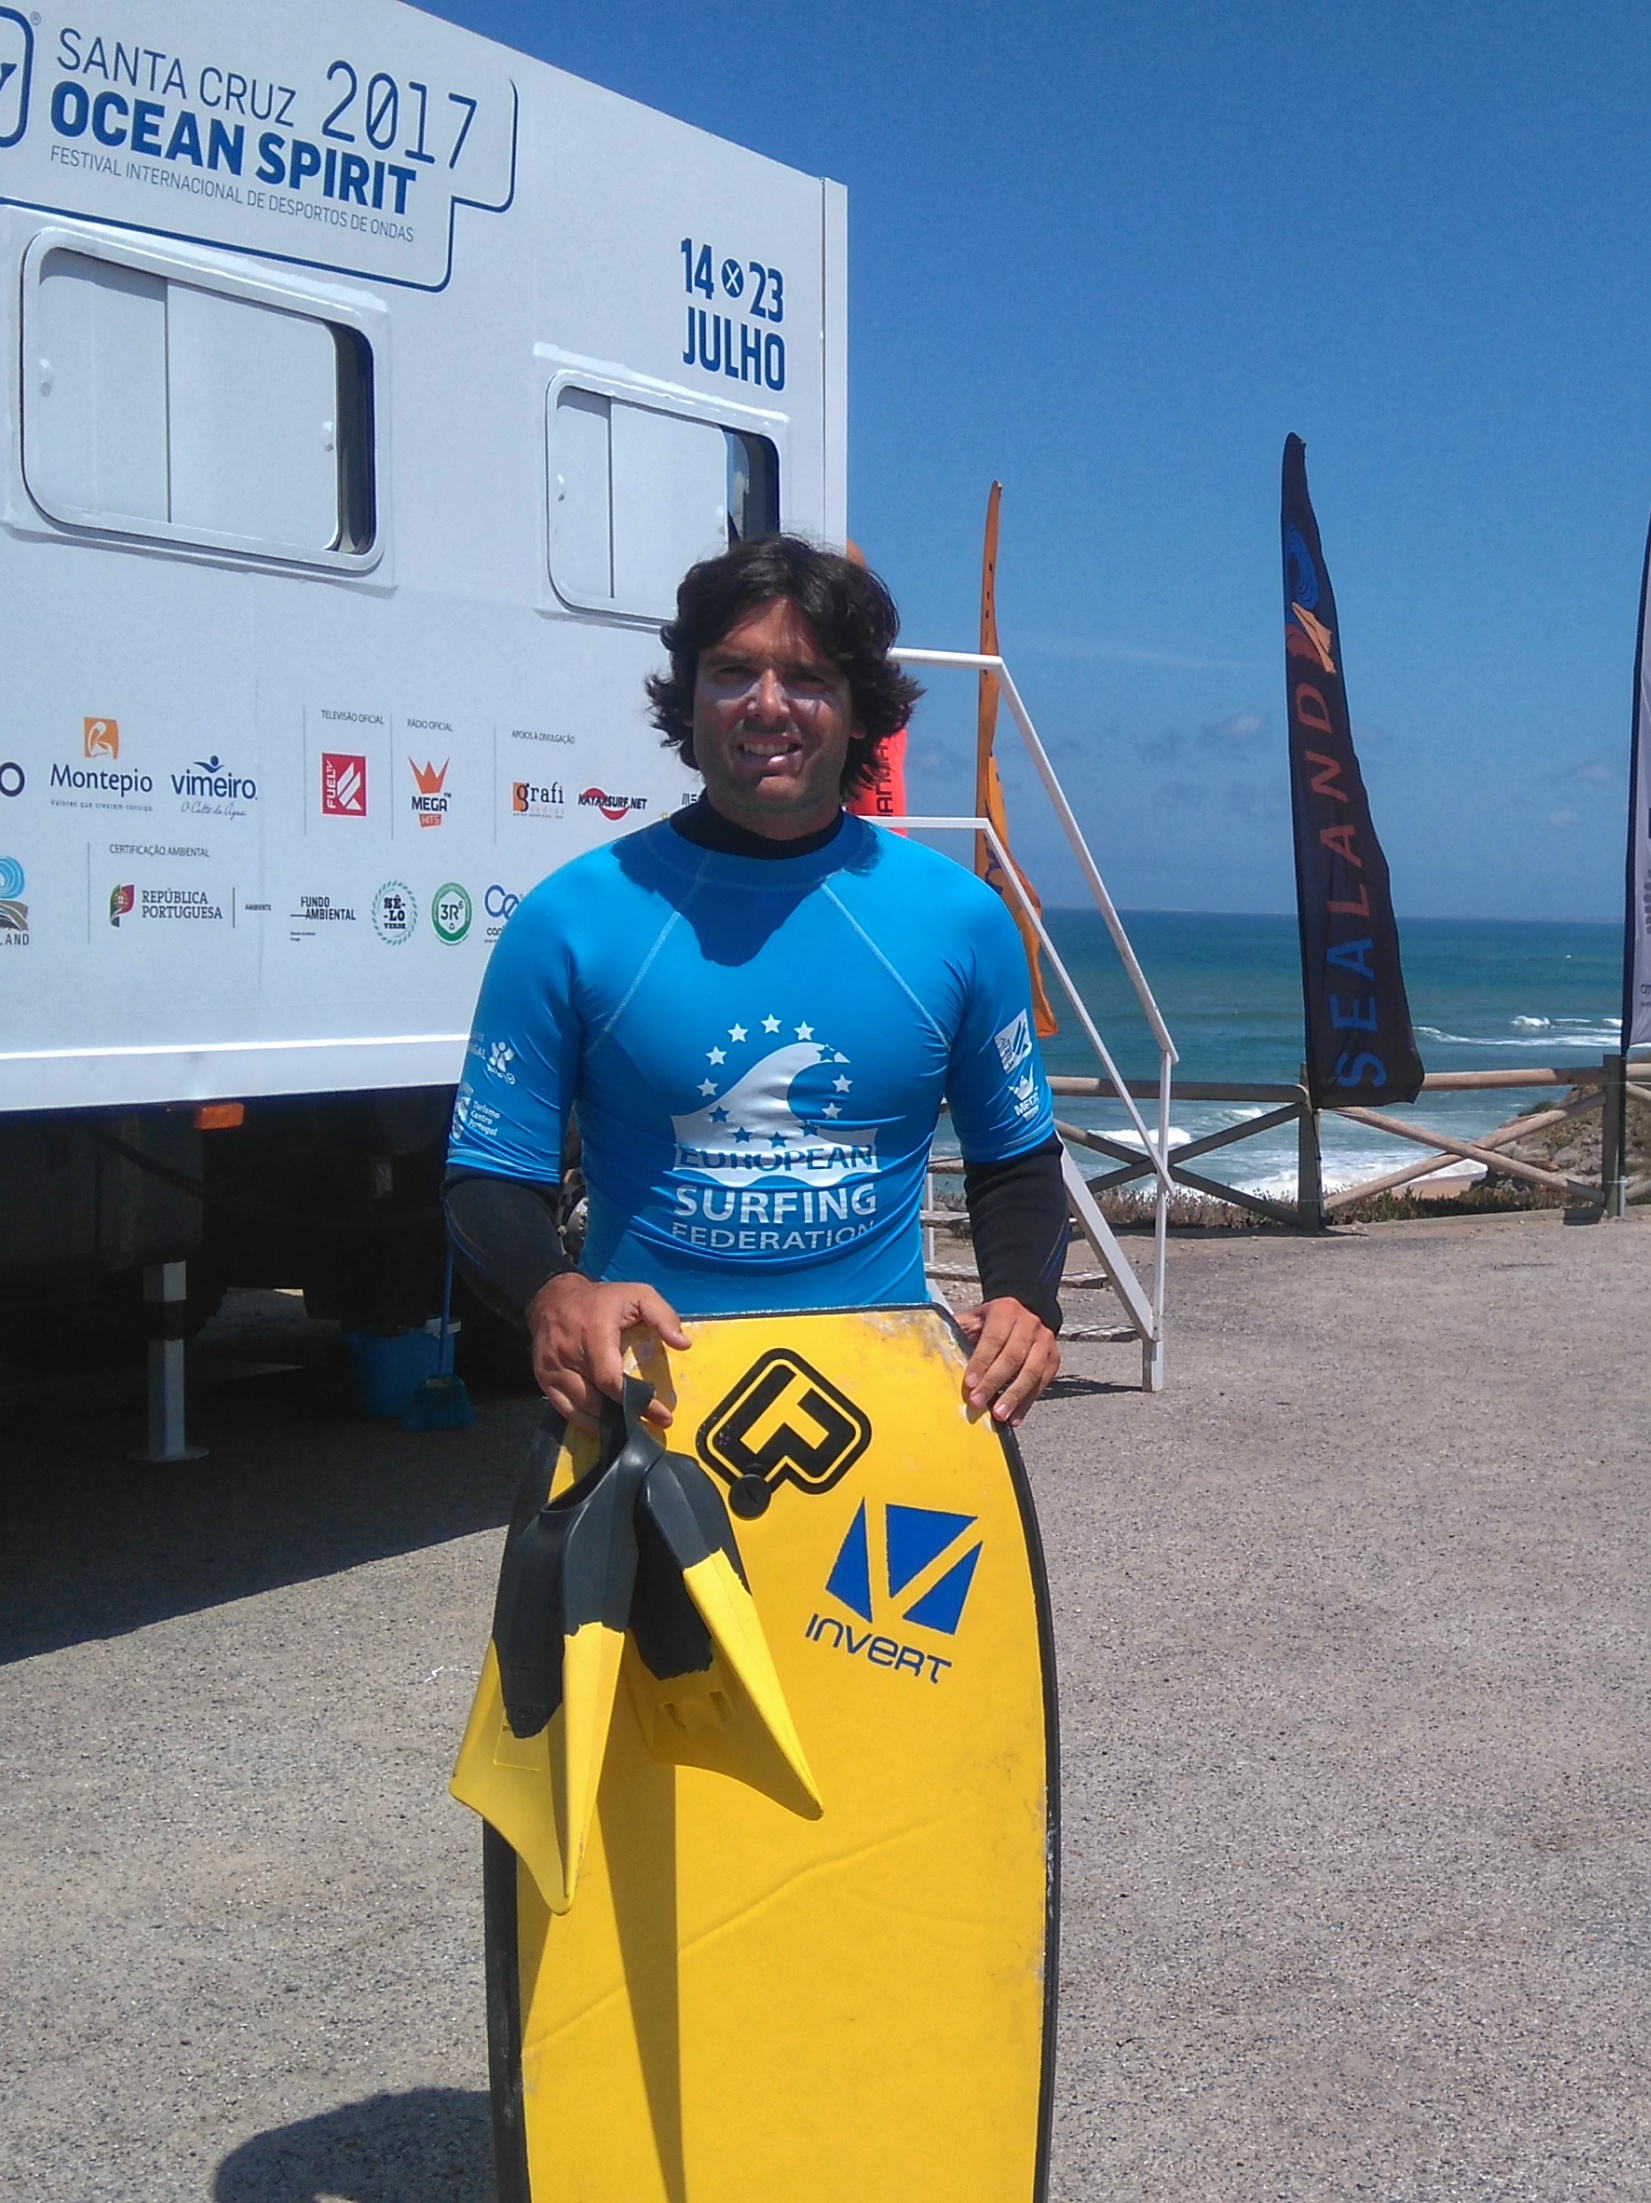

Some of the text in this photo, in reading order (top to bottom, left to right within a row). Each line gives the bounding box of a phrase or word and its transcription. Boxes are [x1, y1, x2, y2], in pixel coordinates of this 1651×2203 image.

[57, 27, 297, 128] SANTA CRUZ
[320, 59, 478, 170] 2017
[50, 80, 417, 215] OCEAN SPIRIT
[50, 145, 414, 243] FESTIVAL INTERNACIONAL DE DESPORTOS DE ONDAS
[680, 237, 784, 323] 14 23
[682, 305, 785, 391] JULHO
[359, 714, 384, 724] OFICIAL
[50, 763, 153, 797] Montepio
[170, 769, 256, 800] vimeiro
[411, 795, 448, 812] MEGA
[516, 782, 564, 812] grafi
[109, 843, 210, 858] CERTIFICAÇÃO AMBIENTAL
[141, 888, 209, 904] REPÚBLICA
[1296, 682, 1388, 1089] SEALAND
[141, 905, 223, 919] PORTUGUESA
[244, 903, 272, 911] AMBIENTE
[300, 896, 330, 908] FUNDO
[305, 908, 357, 921] AMBIENTAL
[0, 933, 30, 945] AND
[678, 1144, 873, 1172] EUROPEAN
[673, 1182, 877, 1225] SURFING
